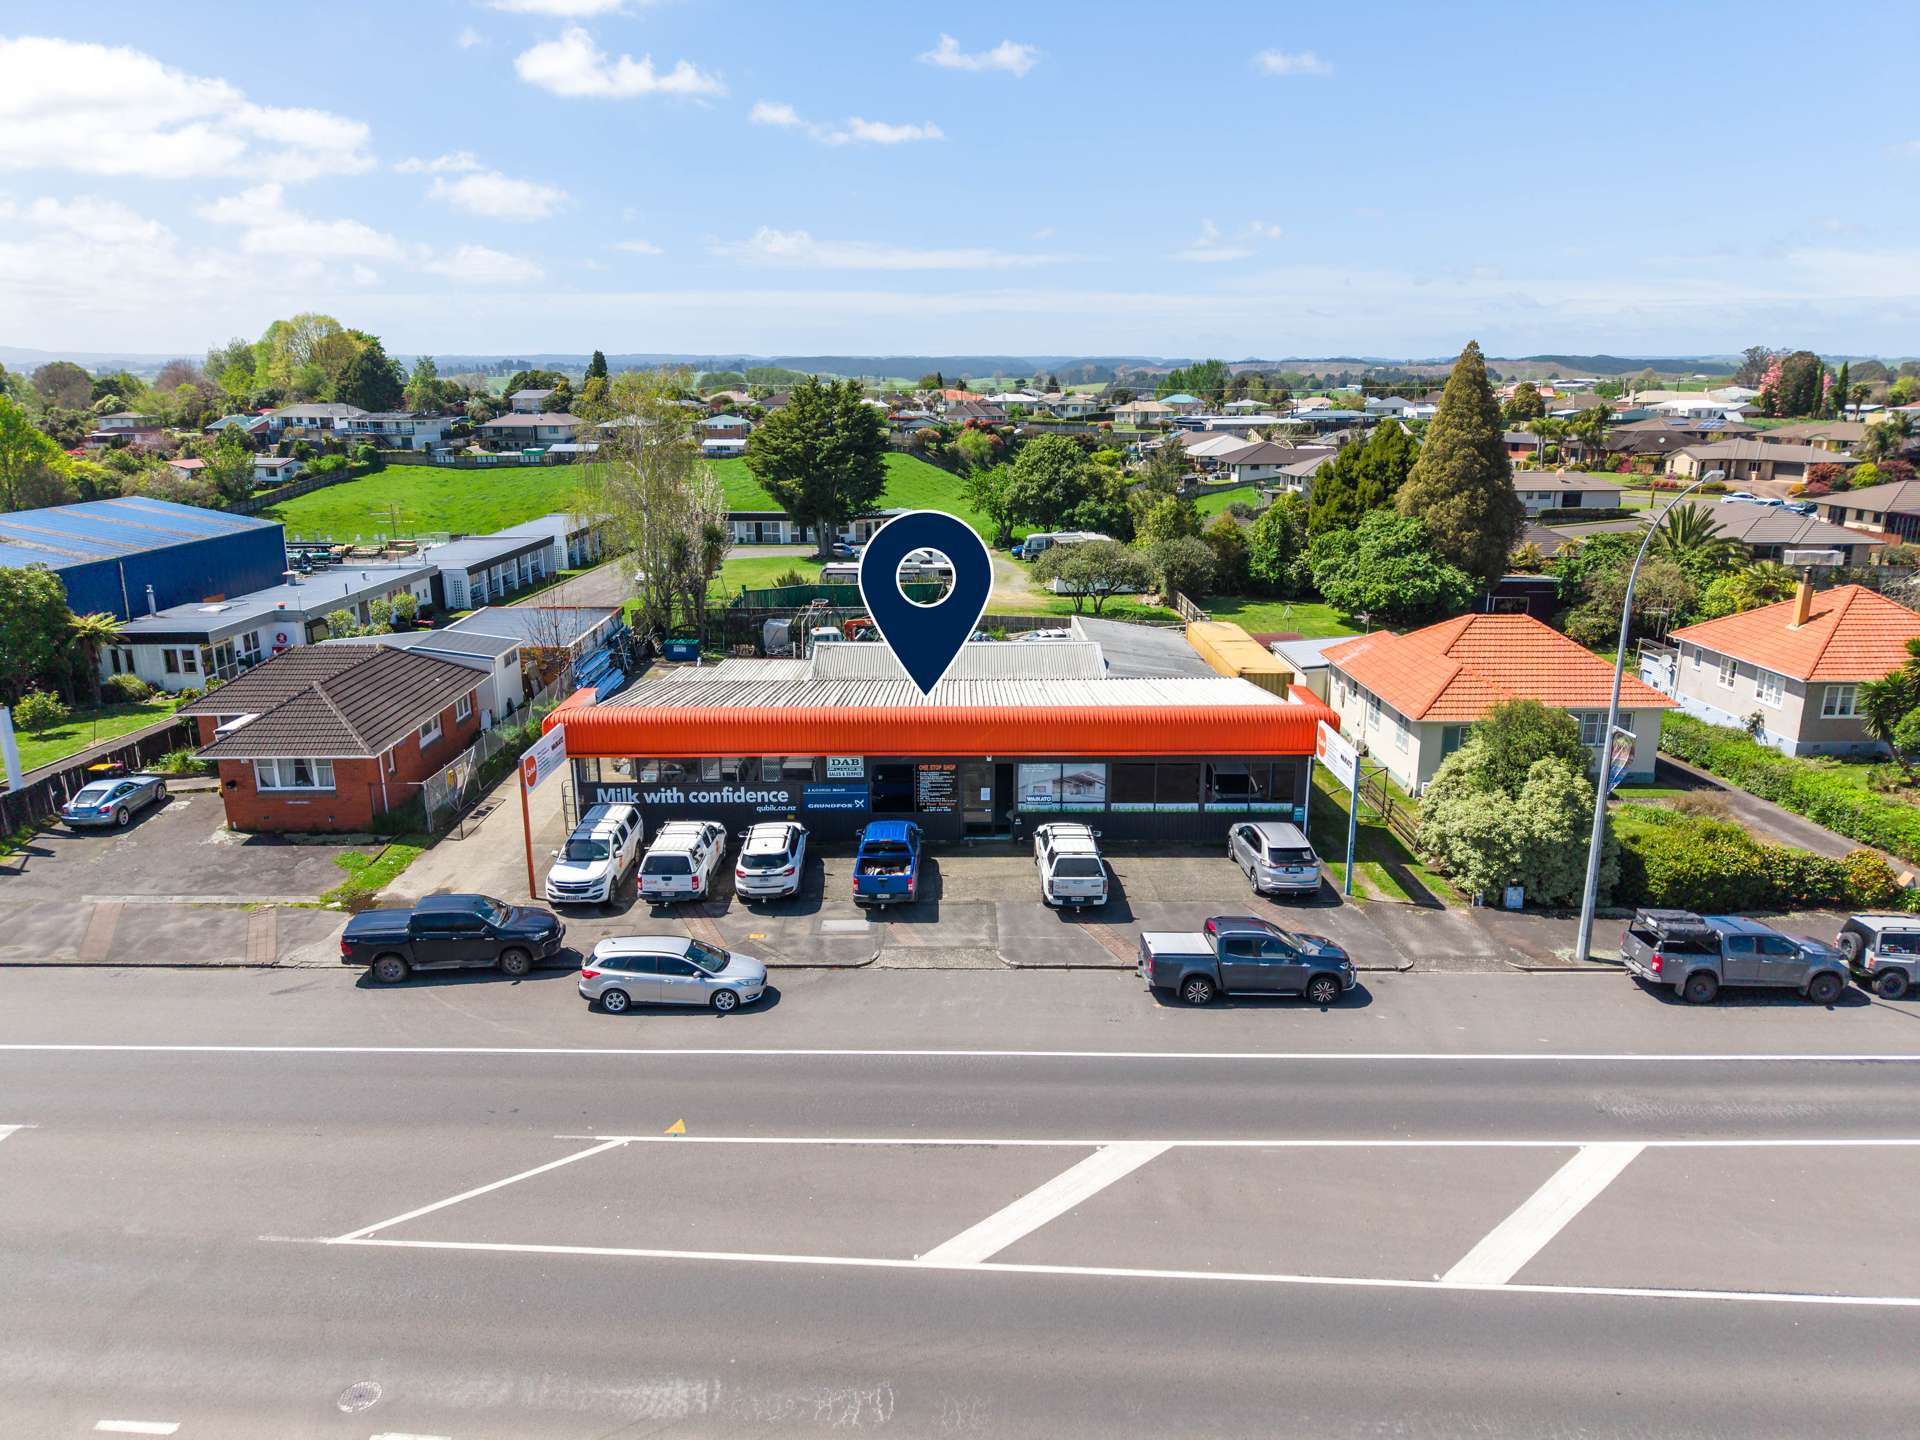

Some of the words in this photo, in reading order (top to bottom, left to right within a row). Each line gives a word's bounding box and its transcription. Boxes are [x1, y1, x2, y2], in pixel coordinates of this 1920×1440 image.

[831, 758, 860, 766] DAB
[596, 787, 640, 803] Milk
[643, 787, 685, 804] with
[688, 786, 790, 804] confidence
[756, 804, 796, 813] qubik.co.nz
